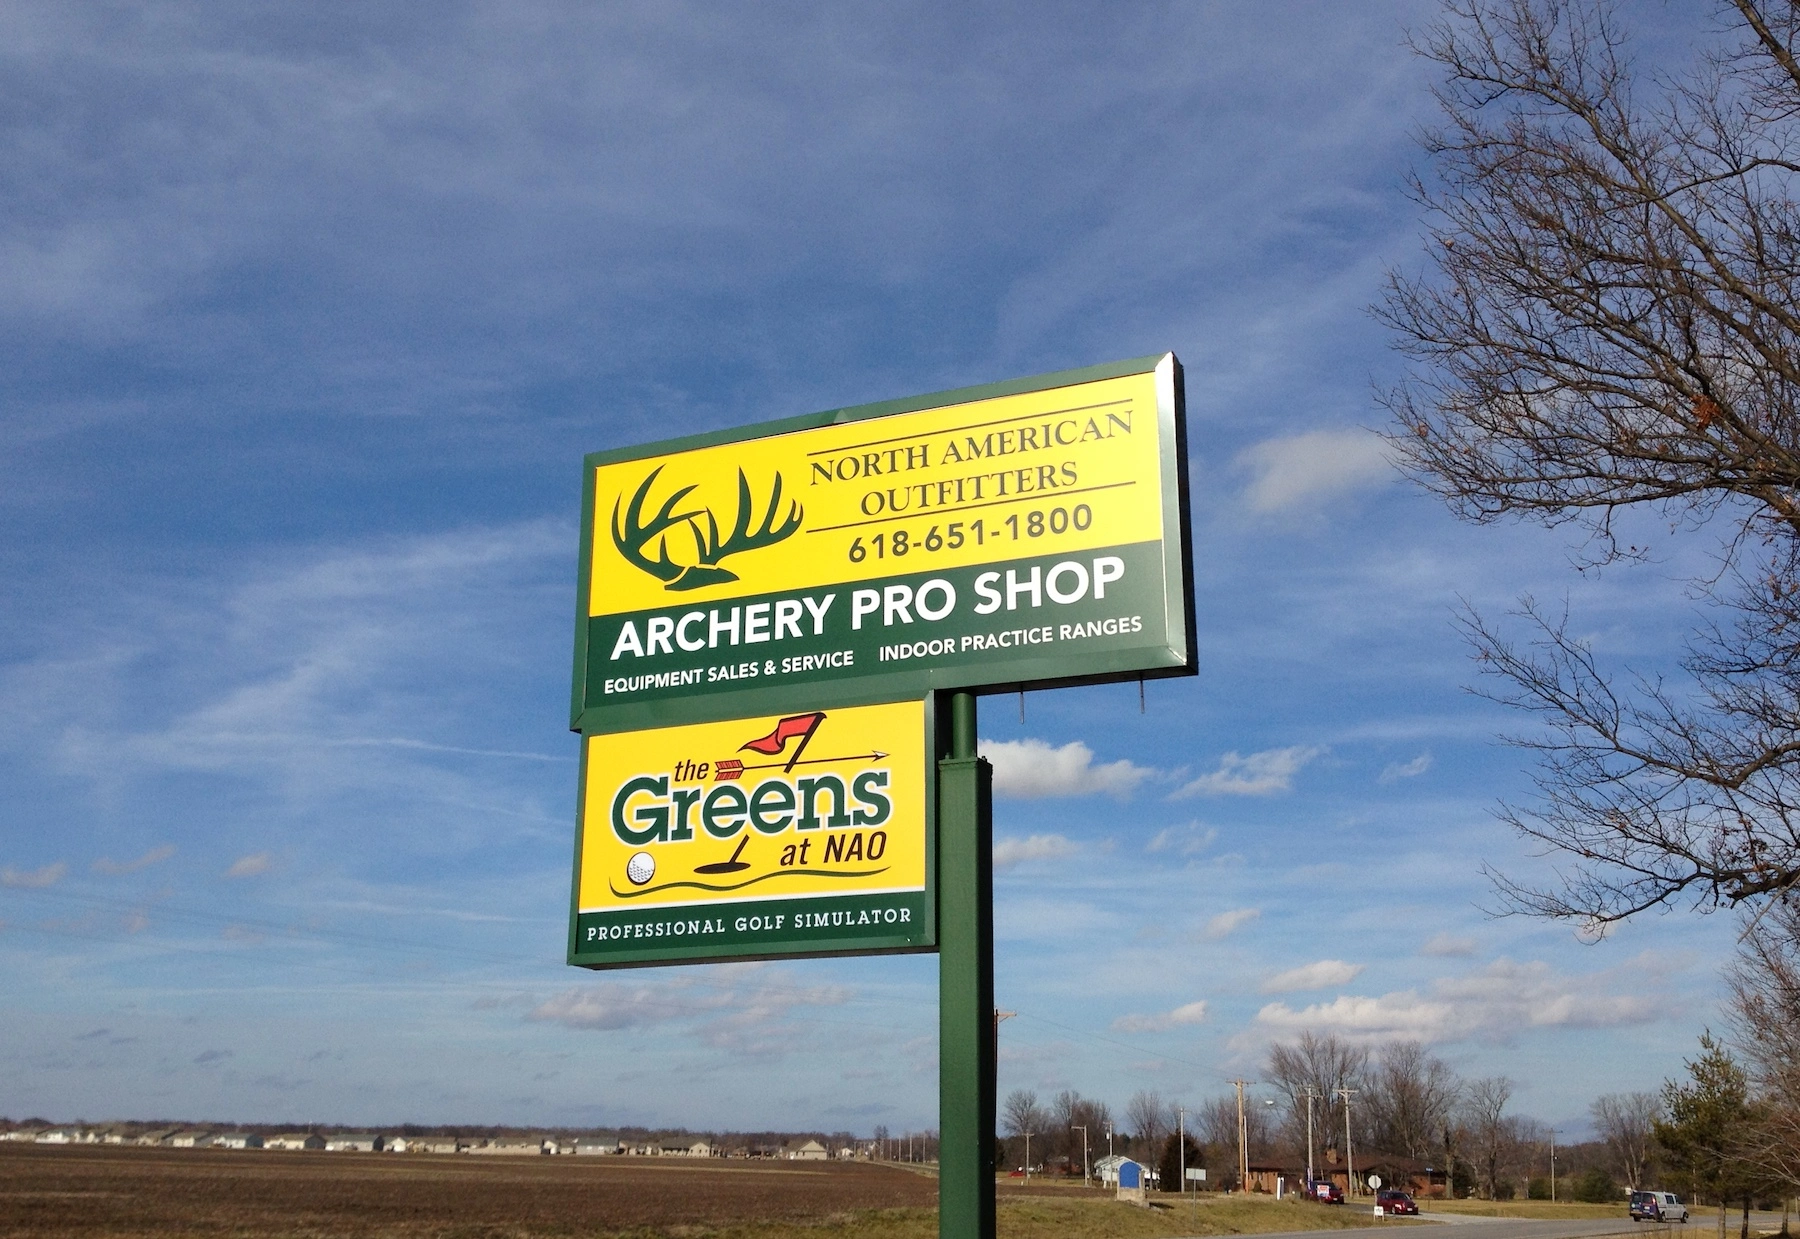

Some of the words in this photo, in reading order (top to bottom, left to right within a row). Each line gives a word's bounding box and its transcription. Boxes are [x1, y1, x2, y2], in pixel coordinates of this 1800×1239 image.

[810, 443, 931, 486] NORTH
[941, 410, 1133, 465] AMERICAN
[861, 462, 1078, 517] OUTFITTERS
[848, 504, 1092, 563] 618-651-1800
[610, 593, 837, 660] ARCHERY
[851, 578, 957, 630] PRO
[973, 556, 1126, 615] SHOP
[879, 638, 956, 661] INDOOR
[961, 626, 1054, 651] PRACTICE
[1060, 616, 1143, 641] RANGES
[604, 669, 703, 694] EQUIPMENT
[707, 662, 759, 683] SALES
[764, 660, 776, 675] &
[781, 650, 854, 673] SERVICE
[674, 759, 709, 782] the
[611, 770, 892, 845] Greens
[780, 837, 811, 866] at
[823, 831, 887, 863] NAO
[587, 918, 725, 941] PROFESSIONAL
[735, 916, 785, 932] GOLF
[795, 908, 912, 928] SIMULATOR
